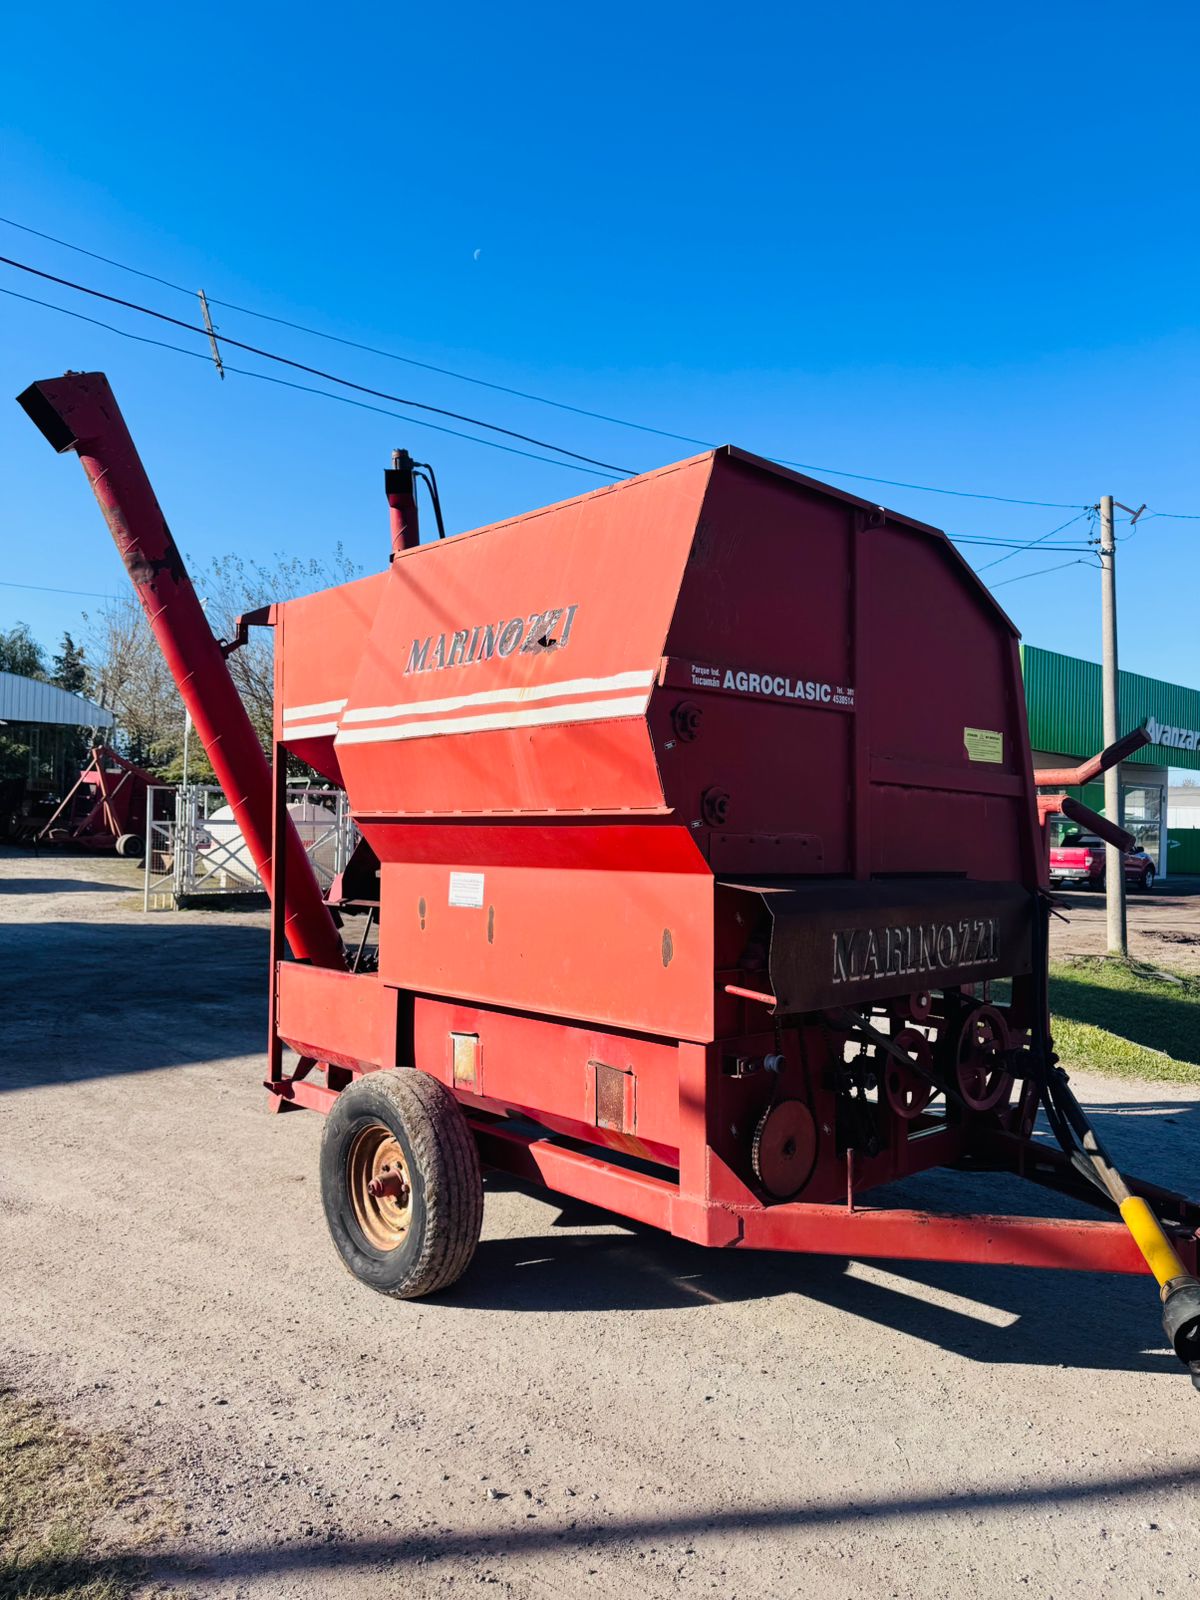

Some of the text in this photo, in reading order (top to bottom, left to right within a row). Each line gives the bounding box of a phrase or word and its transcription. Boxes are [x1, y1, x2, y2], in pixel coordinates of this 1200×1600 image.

[691, 664, 710, 676] Parque
[691, 674, 720, 688] Tucumán
[723, 669, 831, 703] AGROCLASIC
[832, 918, 999, 984] MARINOZZI
